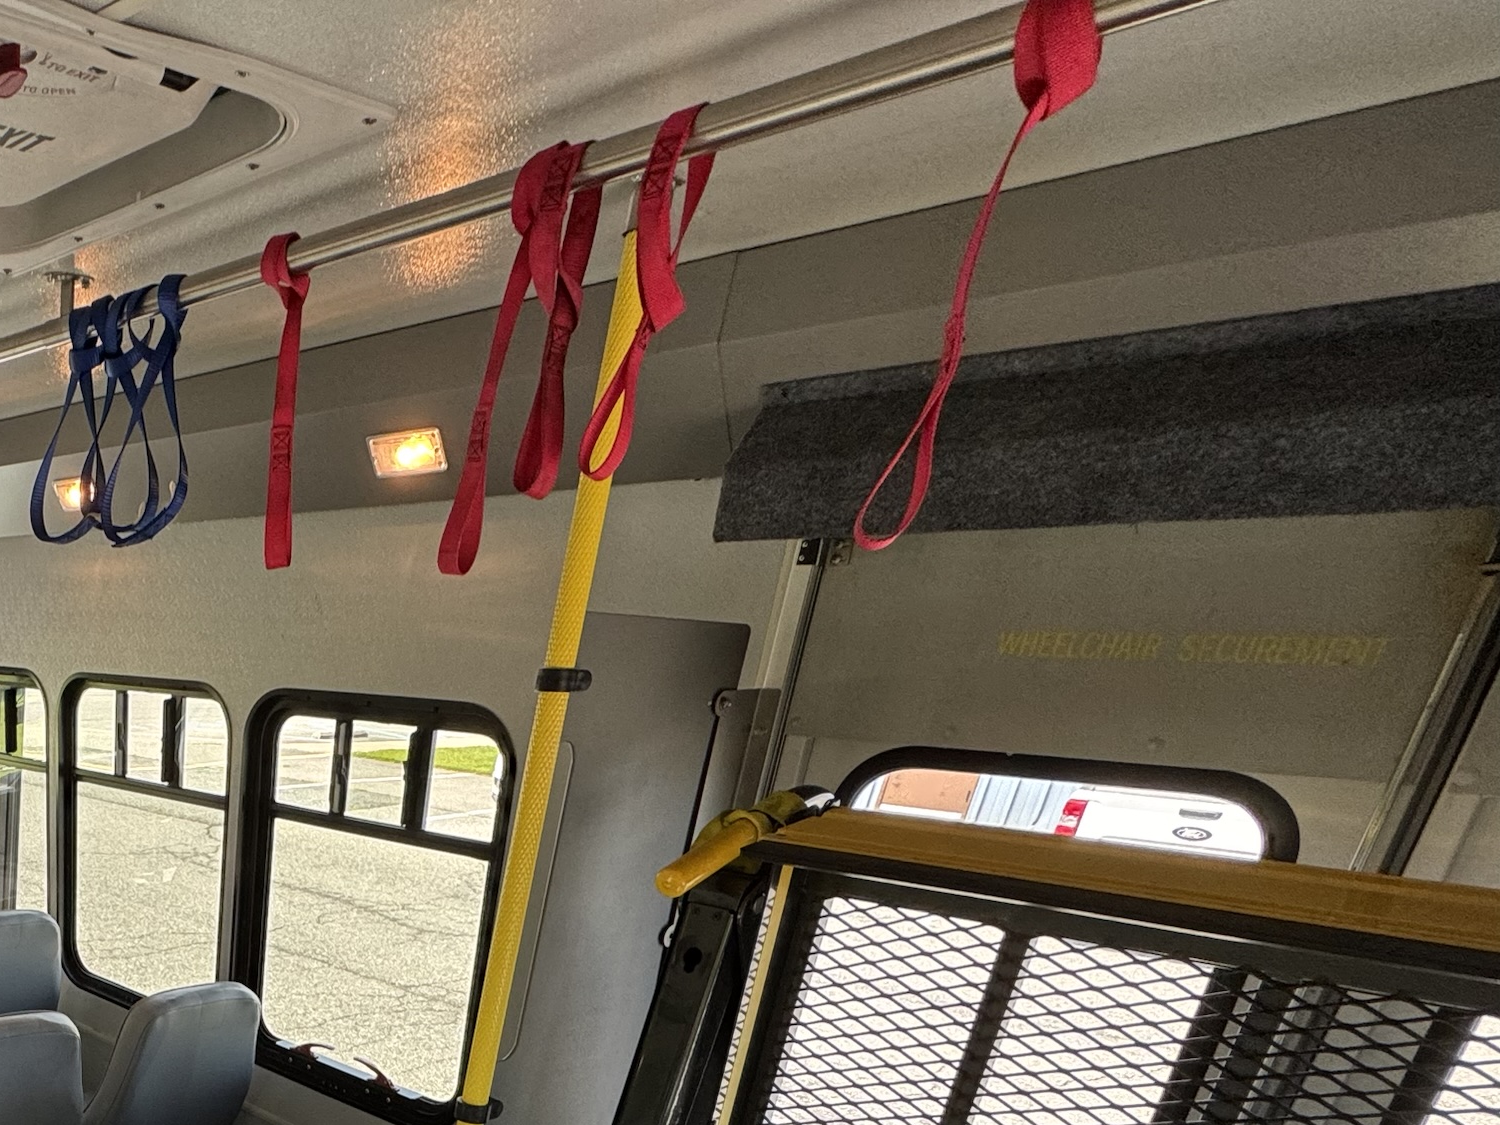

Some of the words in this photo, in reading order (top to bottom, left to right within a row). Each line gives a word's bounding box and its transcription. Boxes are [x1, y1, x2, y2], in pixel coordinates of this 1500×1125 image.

[66, 69, 100, 83] EXIT
[998, 630, 1164, 660] WHEELCHAIR
[1177, 633, 1390, 667] SECUREMENT
